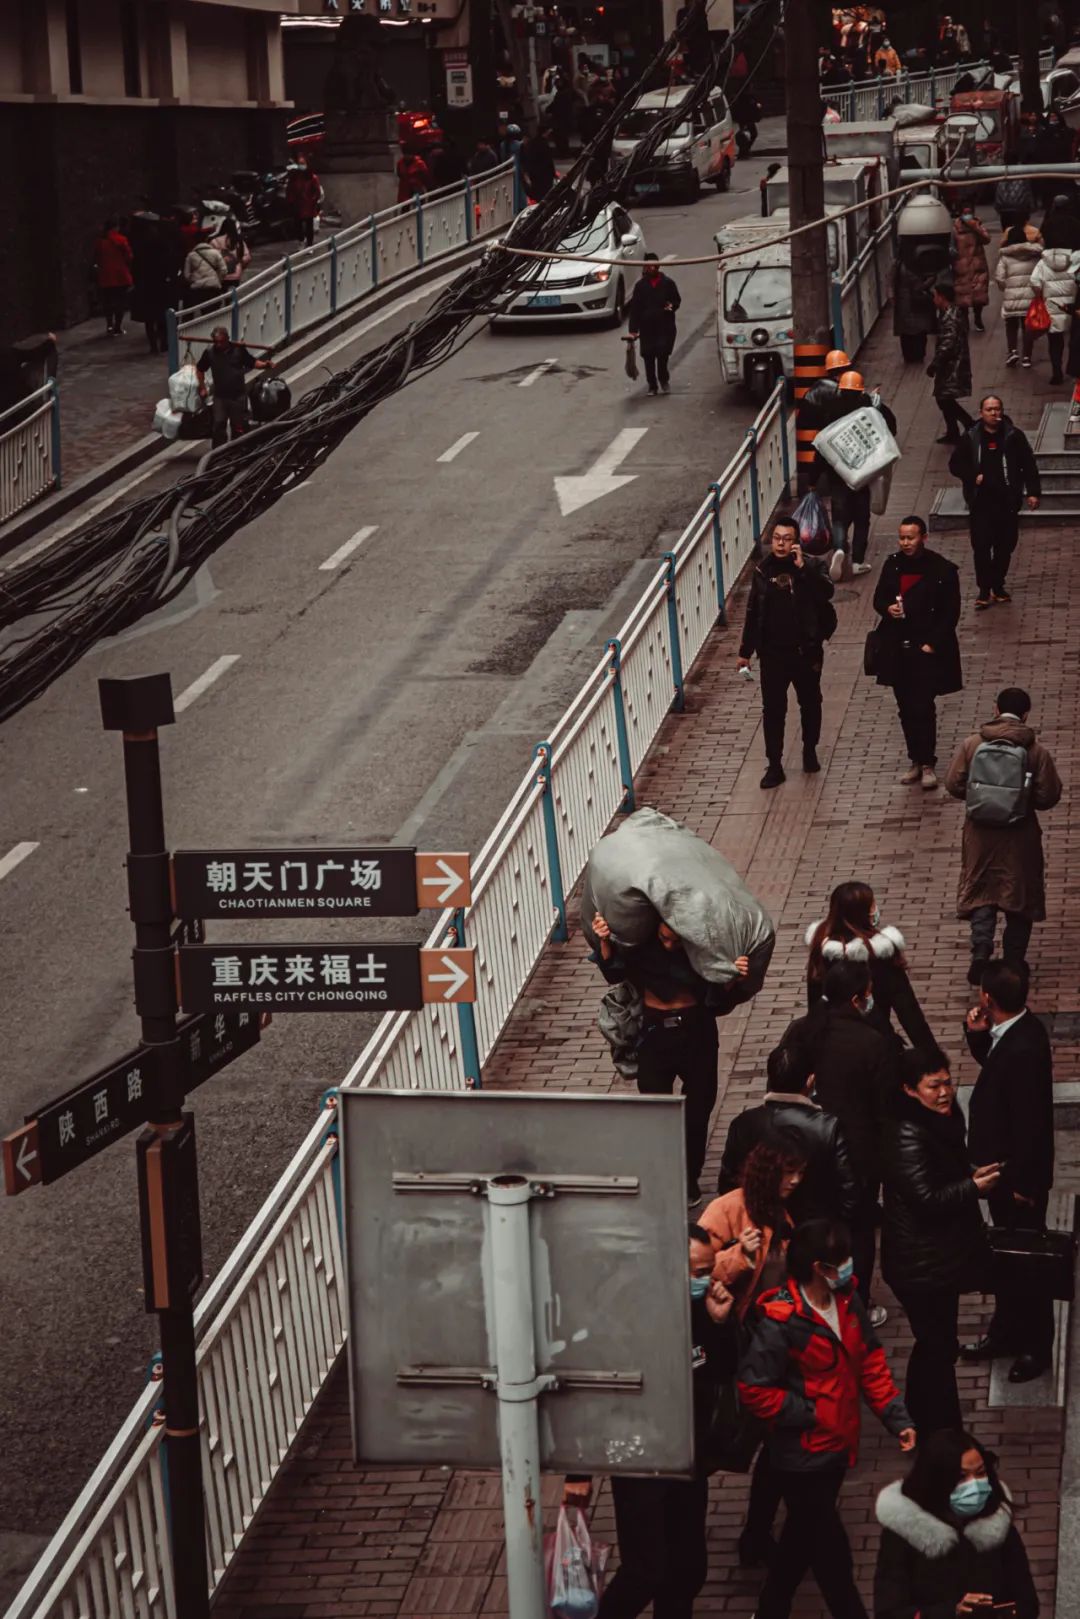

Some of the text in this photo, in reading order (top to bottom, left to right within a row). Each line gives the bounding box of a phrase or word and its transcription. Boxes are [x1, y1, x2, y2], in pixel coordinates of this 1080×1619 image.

[206, 859, 382, 893] 朝天门广场
[218, 896, 371, 909] CHAOTIANMEN SQUARE
[211, 953, 388, 986] 重庆来福士
[213, 990, 388, 1003] RAFFLES CITY CHONGQING
[58, 1068, 143, 1147] 陕西路
